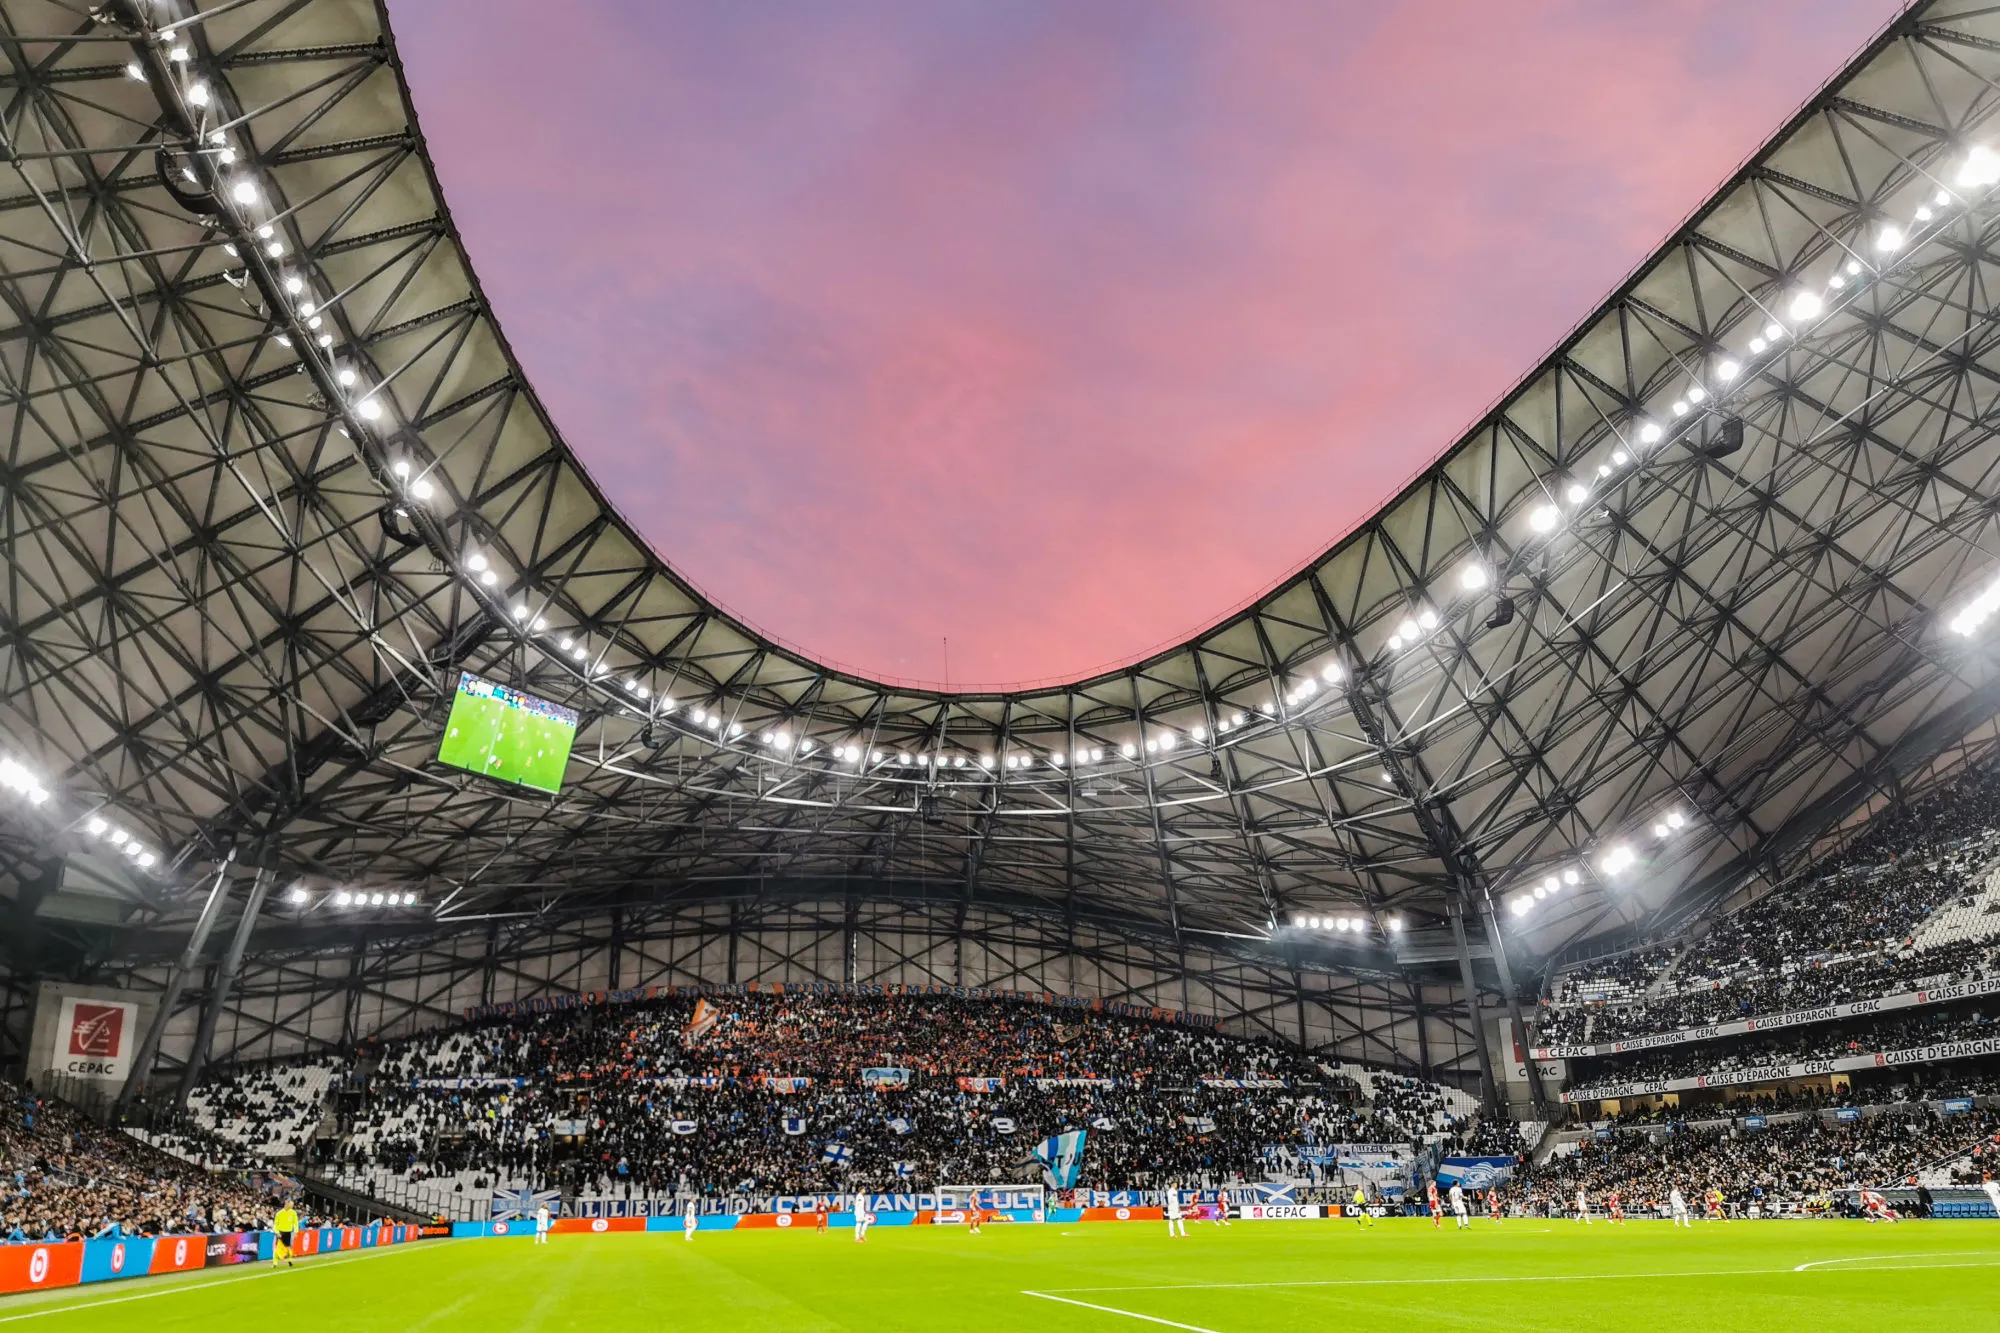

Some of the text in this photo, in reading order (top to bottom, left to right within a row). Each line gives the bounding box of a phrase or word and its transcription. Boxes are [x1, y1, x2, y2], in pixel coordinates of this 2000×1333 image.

[1928, 985, 1964, 1001] CAISSE
[1176, 1010, 1220, 1026] GROUP
[1755, 1000, 1880, 1029] CAISSE D'EPARGNE CEPAC
[1621, 1027, 1719, 1051] CAISSE D'EPARGNE CEPAC
[1550, 1047, 1588, 1057] CEPAC
[1885, 1039, 2000, 1064] CAISSE D'EPARGNE
[68, 1061, 114, 1075] CEPAC
[1519, 1067, 1557, 1077] CPAC
[1706, 1061, 1835, 1086] CAISSE D'EPARGNE CEPAC
[1569, 1081, 1668, 1101] CAISSE D'EPARGNE CEPAC
[1093, 1191, 1130, 1207] 84
[560, 1200, 674, 1217] ALLEZ
[1267, 1206, 1306, 1218] CEPAC
[1346, 1204, 1386, 1216] Ornge
